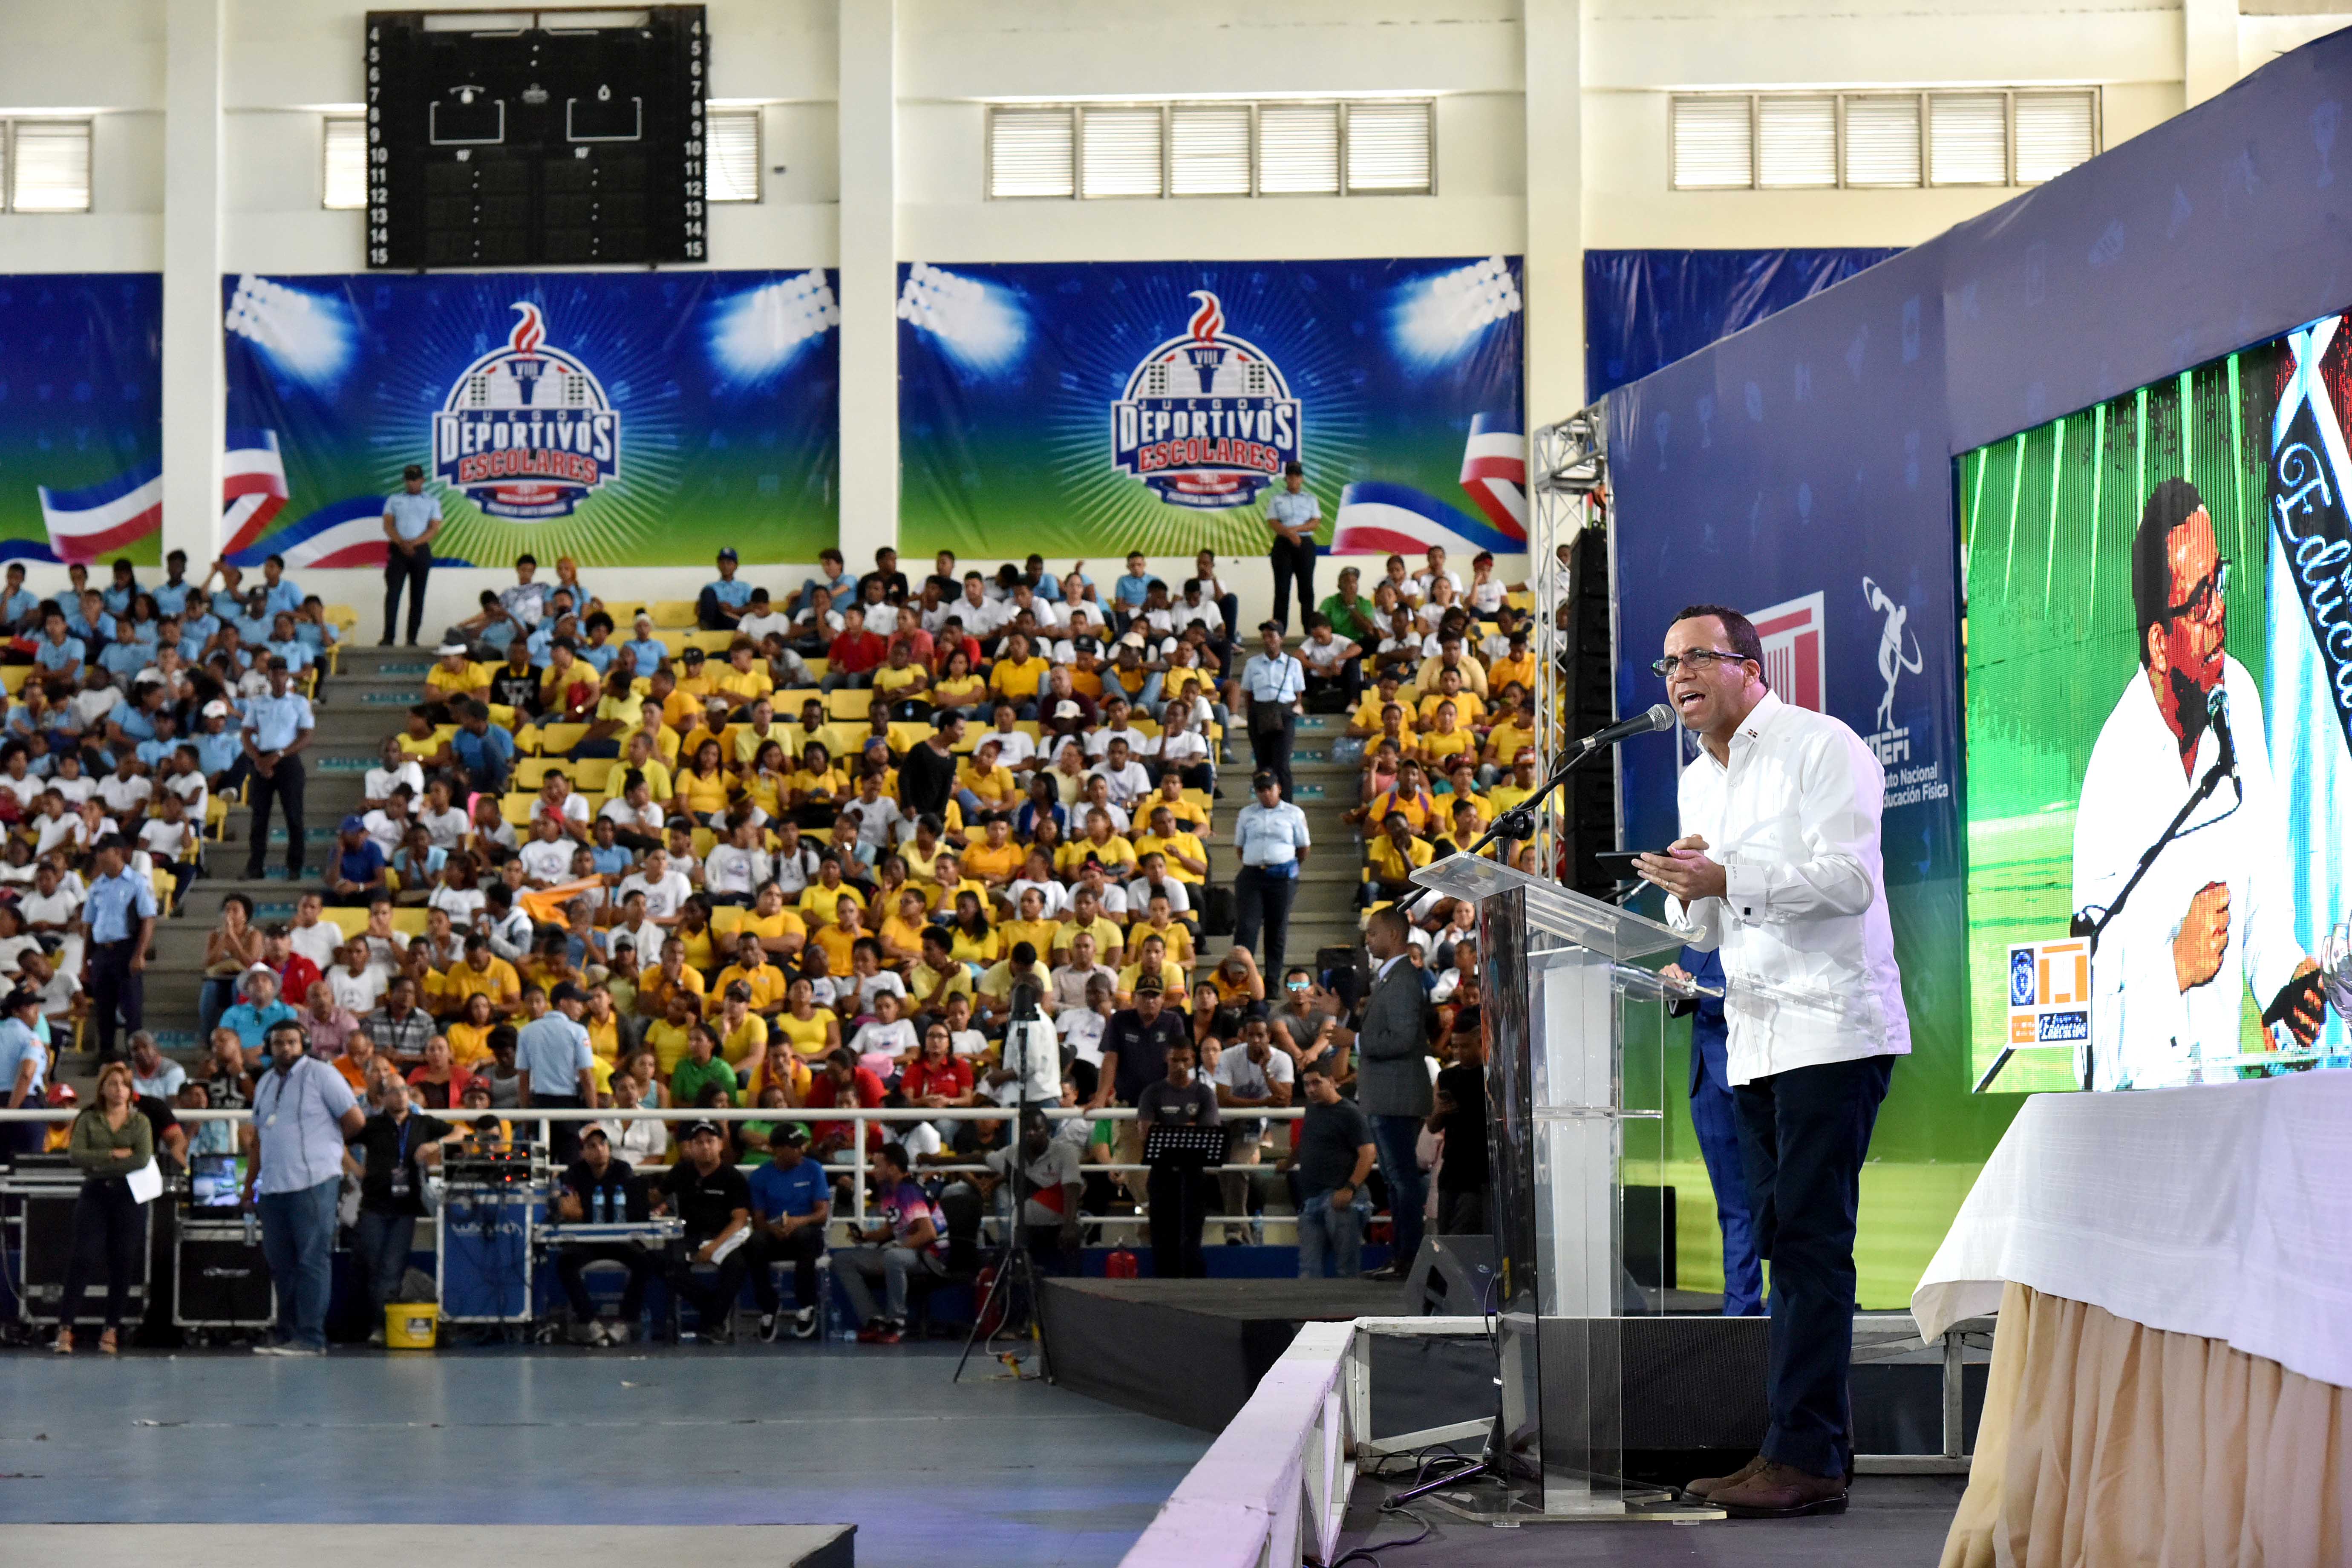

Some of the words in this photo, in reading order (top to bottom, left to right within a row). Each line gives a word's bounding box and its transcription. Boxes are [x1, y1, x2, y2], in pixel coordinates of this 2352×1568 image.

[369, 26, 379, 42] 4
[691, 20, 701, 36] 4
[369, 46, 380, 63] 5
[691, 40, 702, 56] 5
[369, 66, 380, 83] 6
[691, 60, 701, 76] 6
[370, 86, 380, 102] 7
[691, 80, 702, 96] 7
[370, 147, 388, 164] 10
[684, 140, 702, 157] 10
[370, 167, 386, 184] 11
[684, 160, 701, 176] 11
[370, 187, 388, 204] 12
[684, 180, 702, 197] 12
[370, 207, 388, 224] 13
[684, 200, 702, 217] 13
[370, 227, 388, 244] 14
[684, 220, 702, 236] 14
[370, 248, 388, 265] 15
[684, 240, 702, 257] 15
[1195, 350, 1219, 364] VIII
[1138, 399, 1273, 410] JUEGOS
[460, 409, 593, 422] JUEGOS
[1120, 404, 1293, 453] DEPORTIVOS
[441, 415, 611, 464] DEPORTIVOS
[1139, 438, 1278, 473] ESCOLARES
[459, 448, 597, 484] ESCOLARES
[2277, 442, 2352, 739] Educa
[1863, 727, 1909, 766] NEFI
[1900, 761, 1937, 786] Nacional
[1883, 784, 1921, 809] ducación
[1923, 781, 1949, 801] Física
